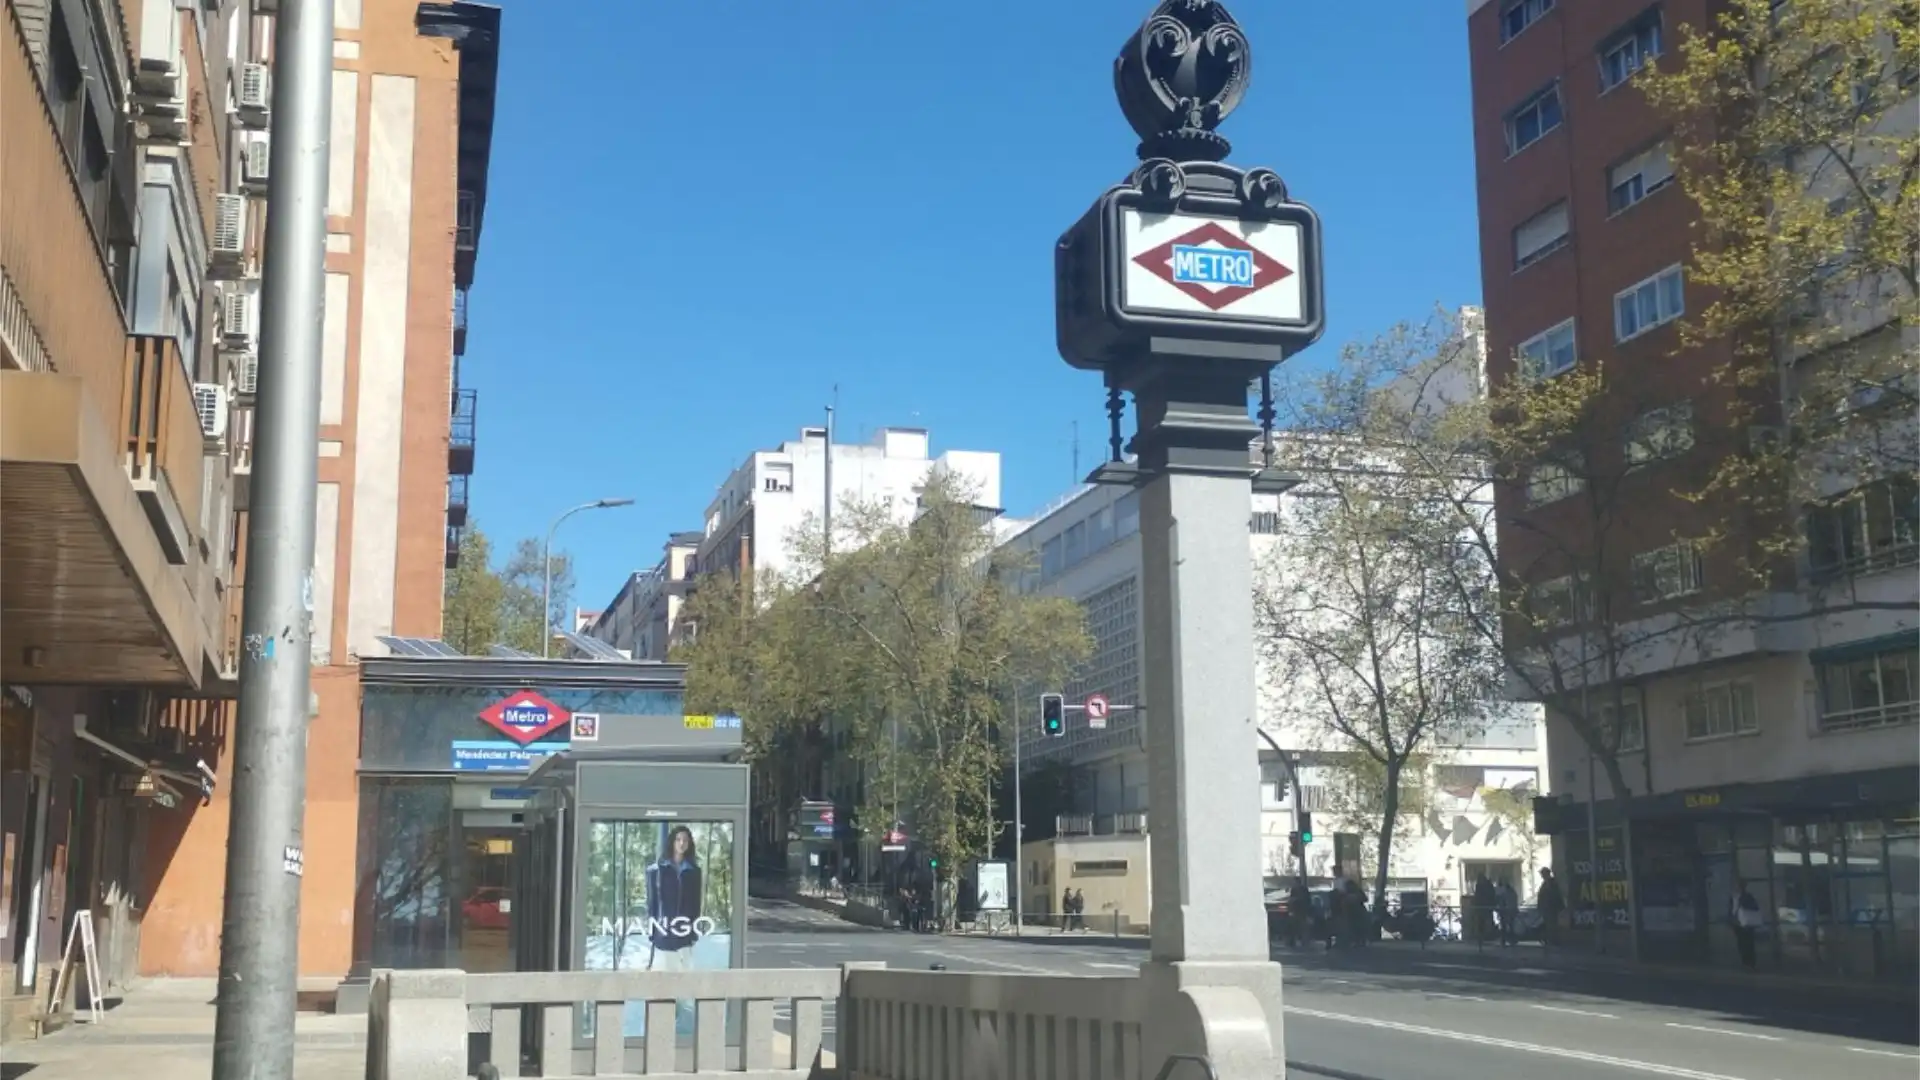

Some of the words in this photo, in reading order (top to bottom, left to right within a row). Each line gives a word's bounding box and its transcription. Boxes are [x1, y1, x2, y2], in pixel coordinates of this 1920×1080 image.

[1175, 251, 1249, 281] METRO
[505, 709, 546, 723] Metro
[602, 916, 715, 937] MANGO
